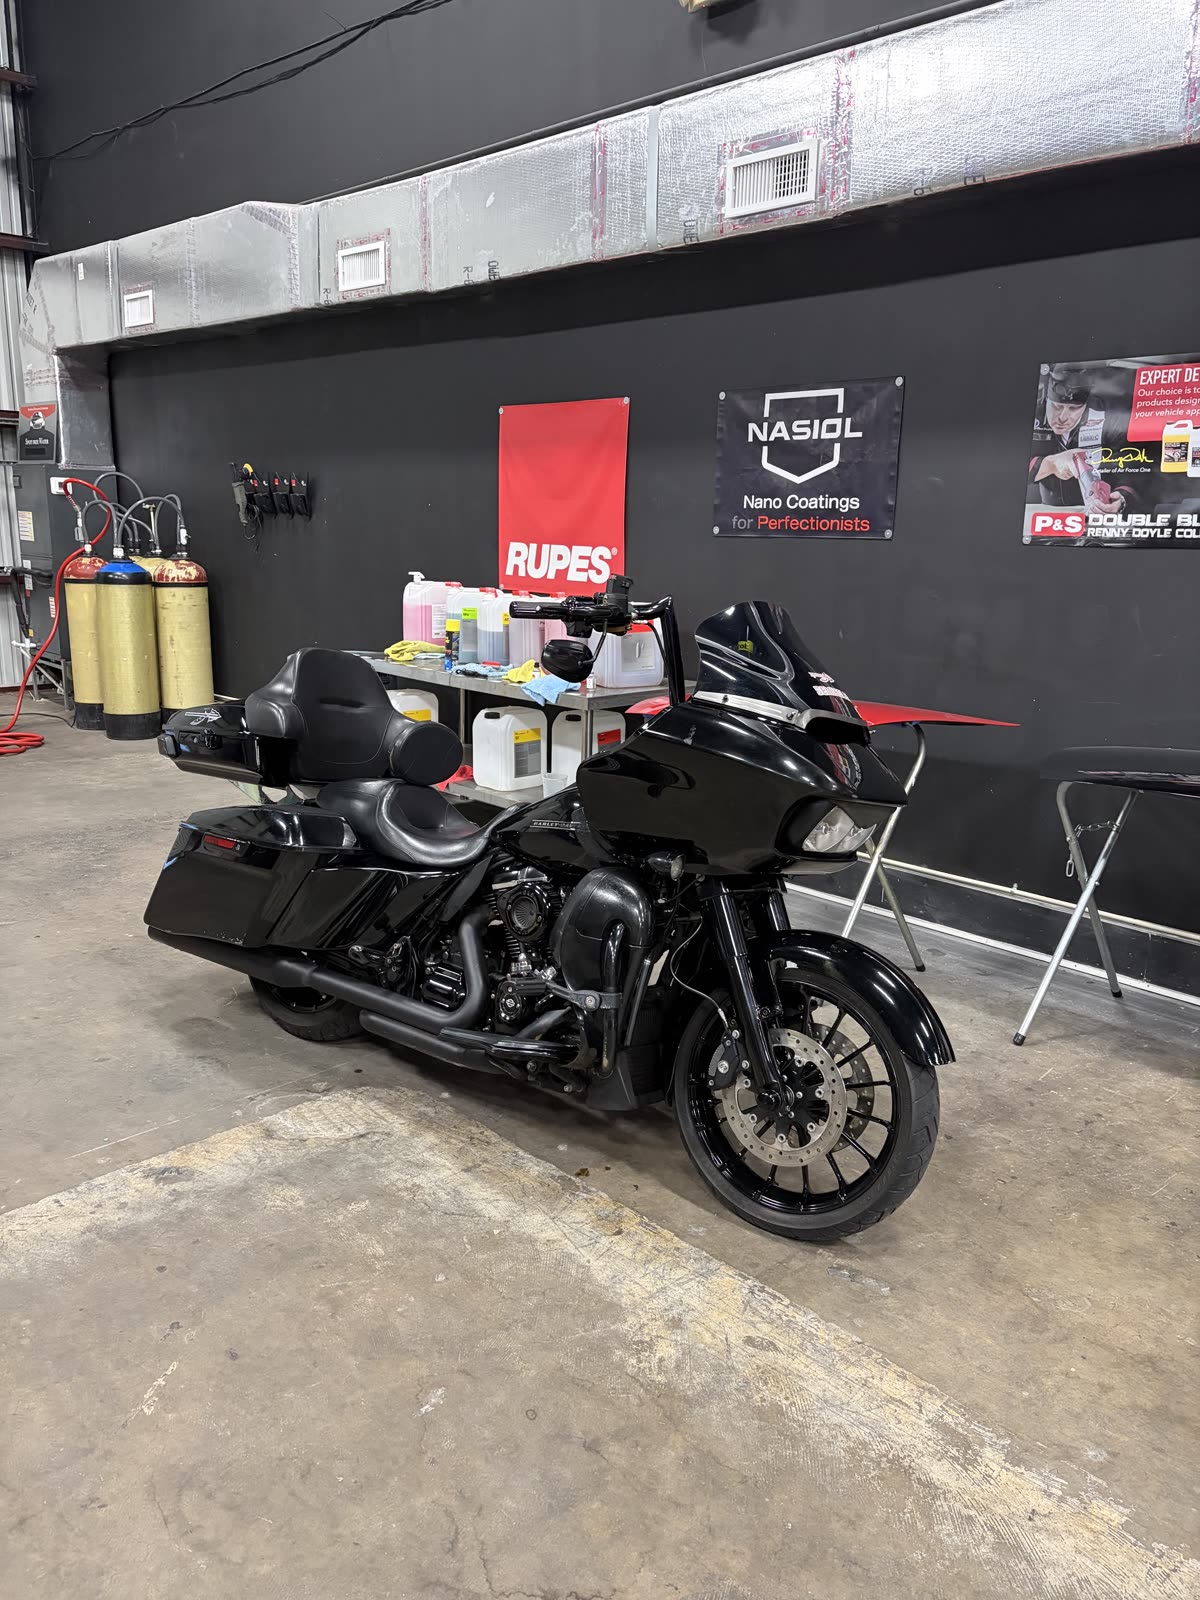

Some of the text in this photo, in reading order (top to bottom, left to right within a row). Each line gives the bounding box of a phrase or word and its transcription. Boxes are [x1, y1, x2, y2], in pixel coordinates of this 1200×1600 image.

[1139, 367, 1200, 385] EXPERT DE
[1137, 388, 1154, 397] Our
[1155, 387, 1182, 396] choice
[1184, 386, 1191, 394] is
[1136, 398, 1173, 409] products
[1134, 408, 1200, 419] your vehicle app
[747, 417, 863, 442] NASIOL
[743, 494, 860, 512] Nano Coatings
[732, 515, 870, 532] for Perfectionists
[1034, 515, 1083, 533] P&S
[1088, 513, 1200, 527] DOUBLE BL
[1086, 527, 1130, 537] RENNY
[1131, 528, 1172, 538] DOYLE
